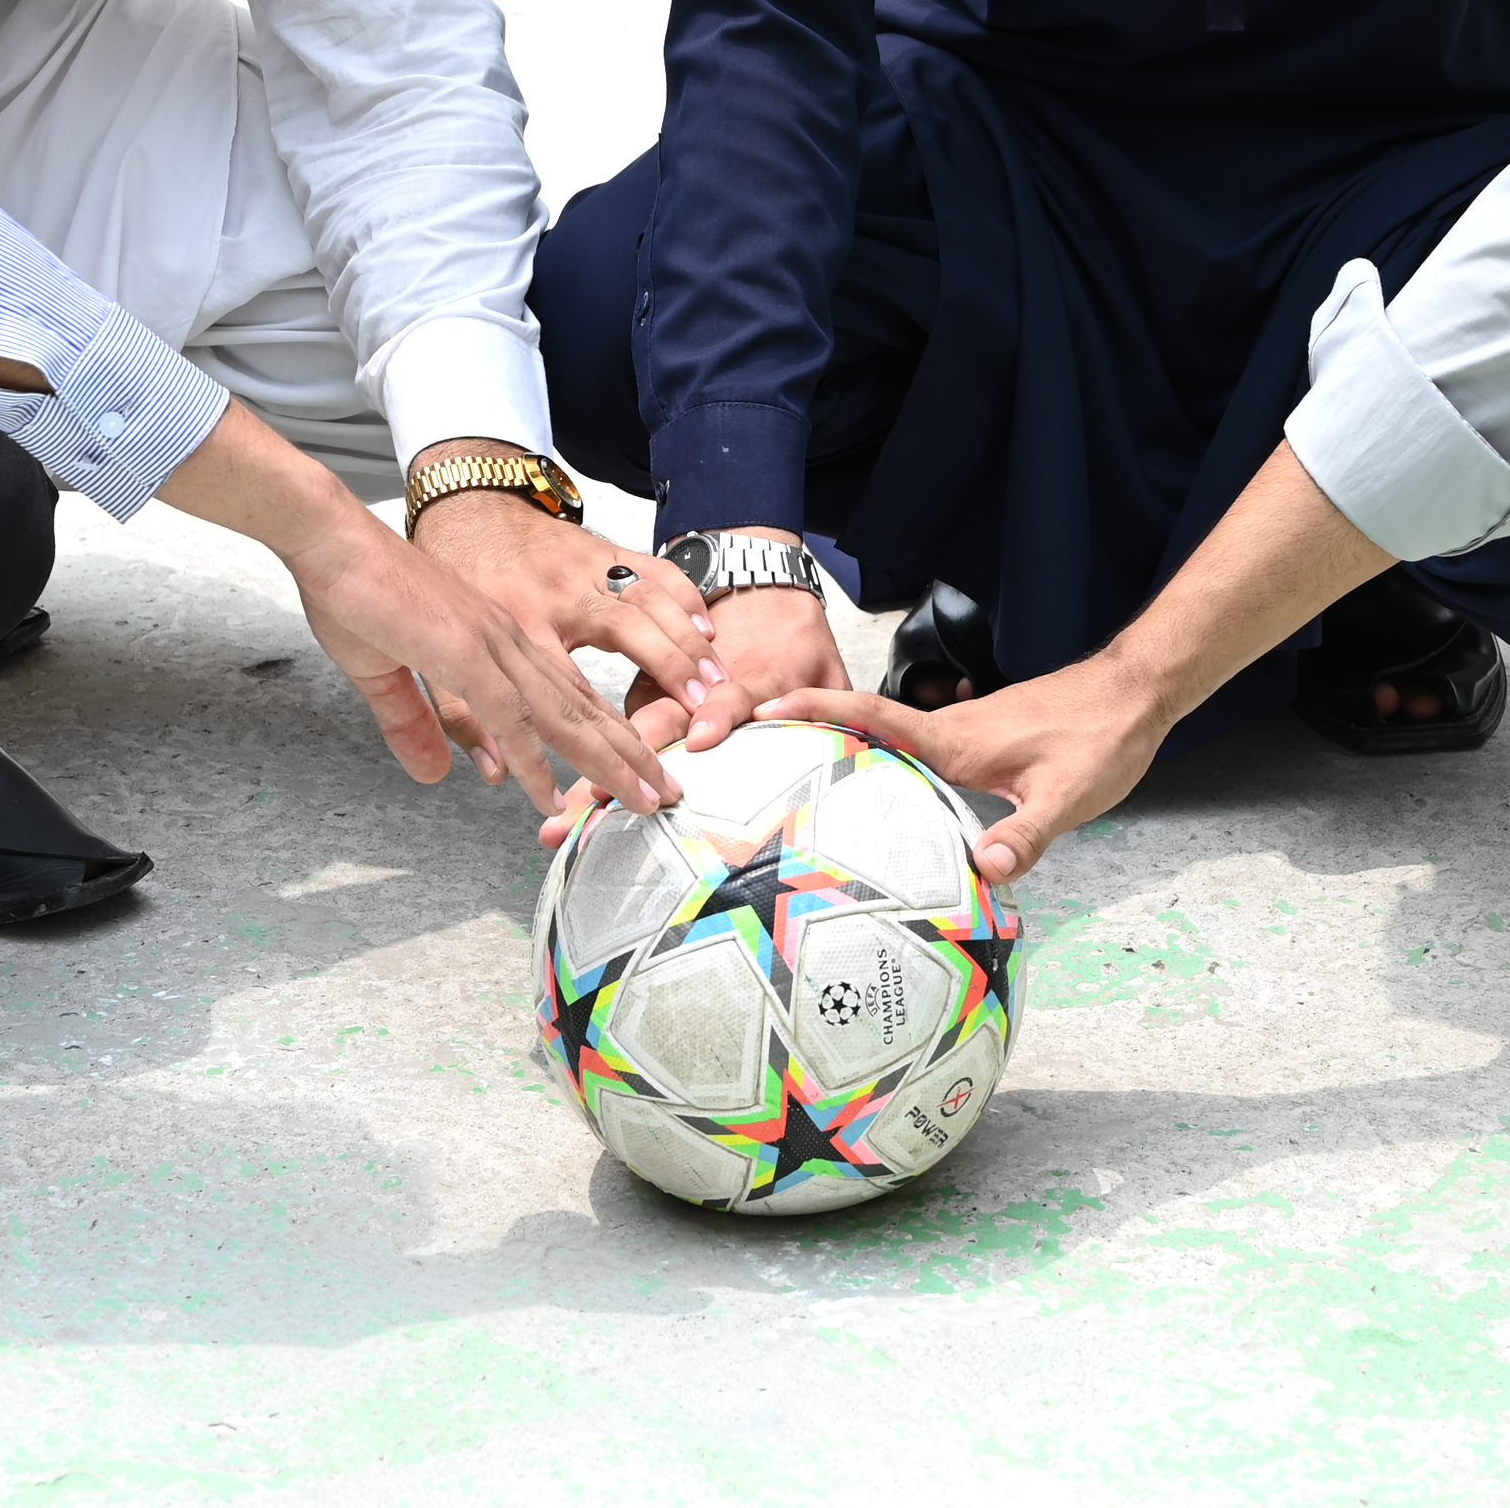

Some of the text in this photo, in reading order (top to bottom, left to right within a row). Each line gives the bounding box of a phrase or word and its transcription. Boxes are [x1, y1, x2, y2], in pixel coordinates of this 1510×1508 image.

[867, 985, 879, 1016] UEFA
[877, 948, 893, 1045] CHAMPIONS
[904, 1105, 949, 1149] POWER
